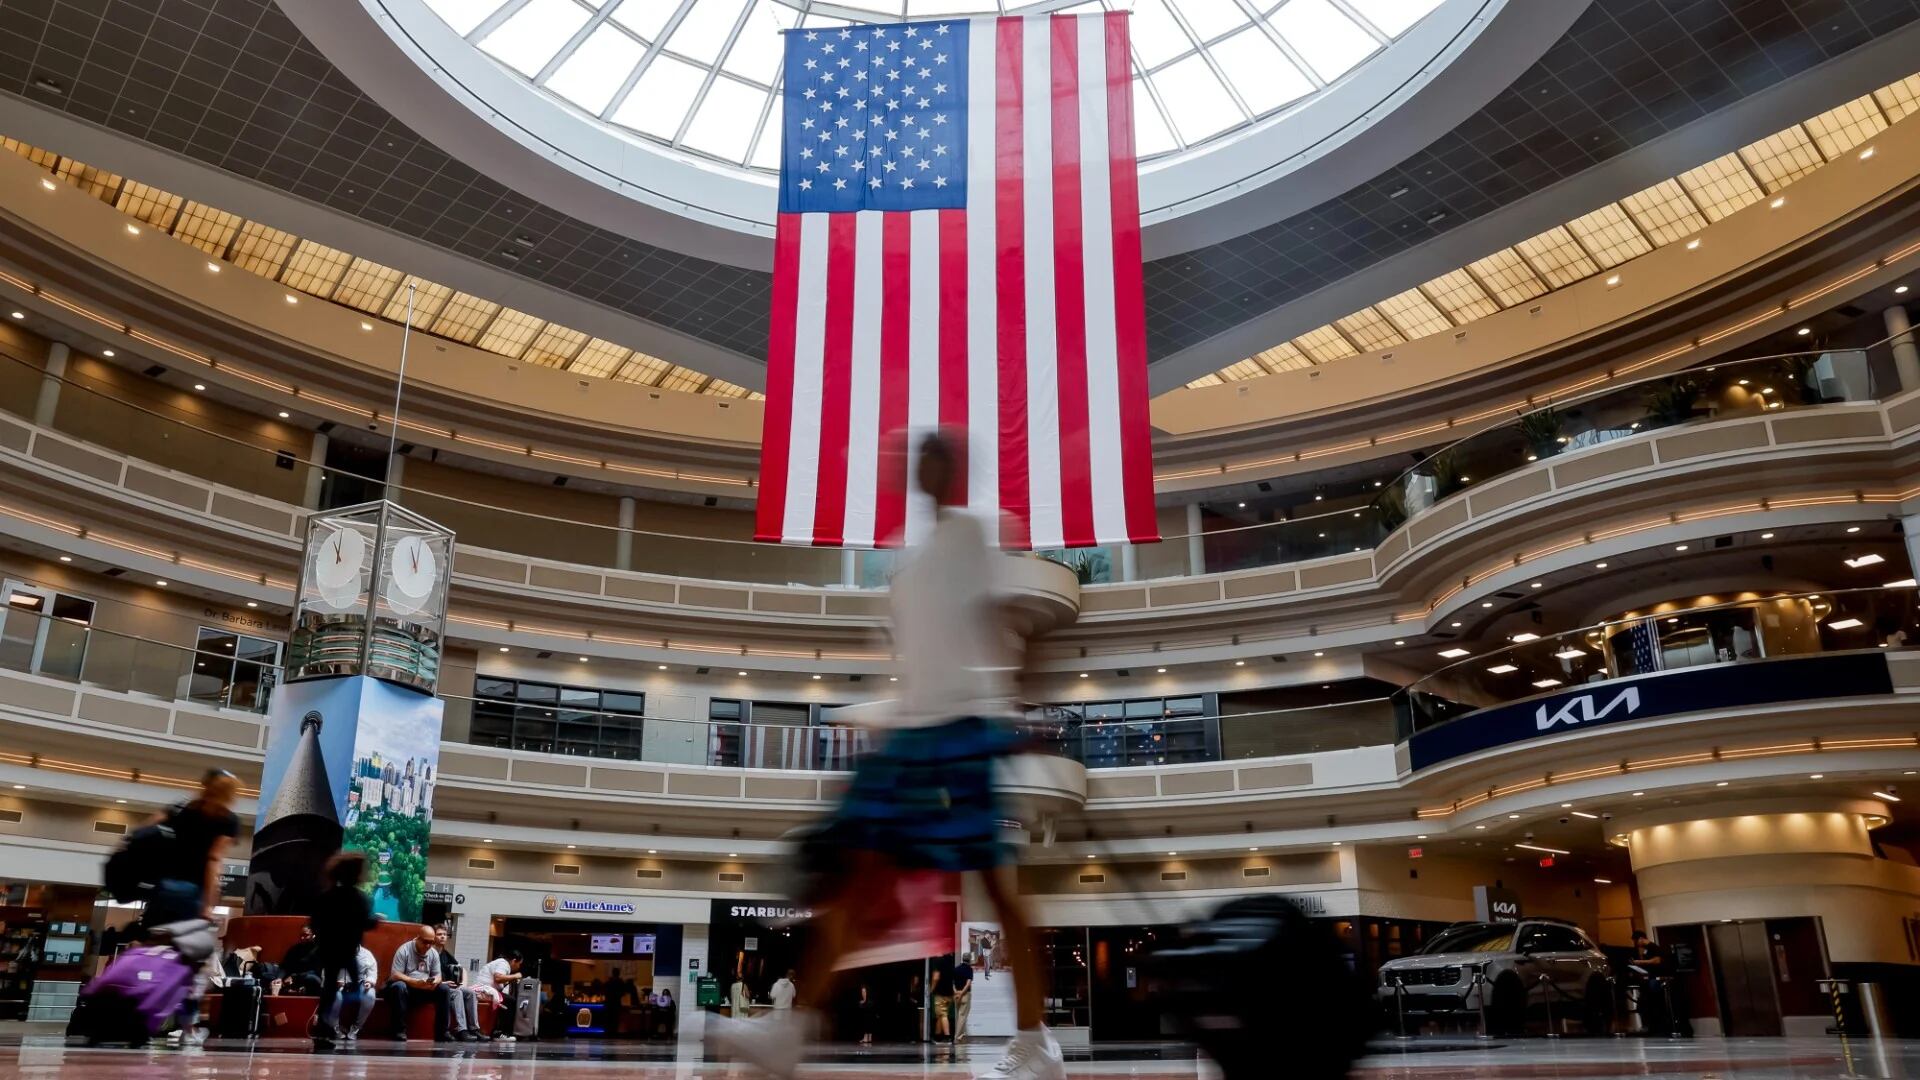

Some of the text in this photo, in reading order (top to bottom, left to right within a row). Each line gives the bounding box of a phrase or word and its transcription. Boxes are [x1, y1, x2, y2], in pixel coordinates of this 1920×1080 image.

[222, 611, 263, 629] Barbara
[1536, 686, 1640, 730] KIA
[563, 900, 634, 912] Auntie Anne's
[1493, 902, 1517, 914] KIA
